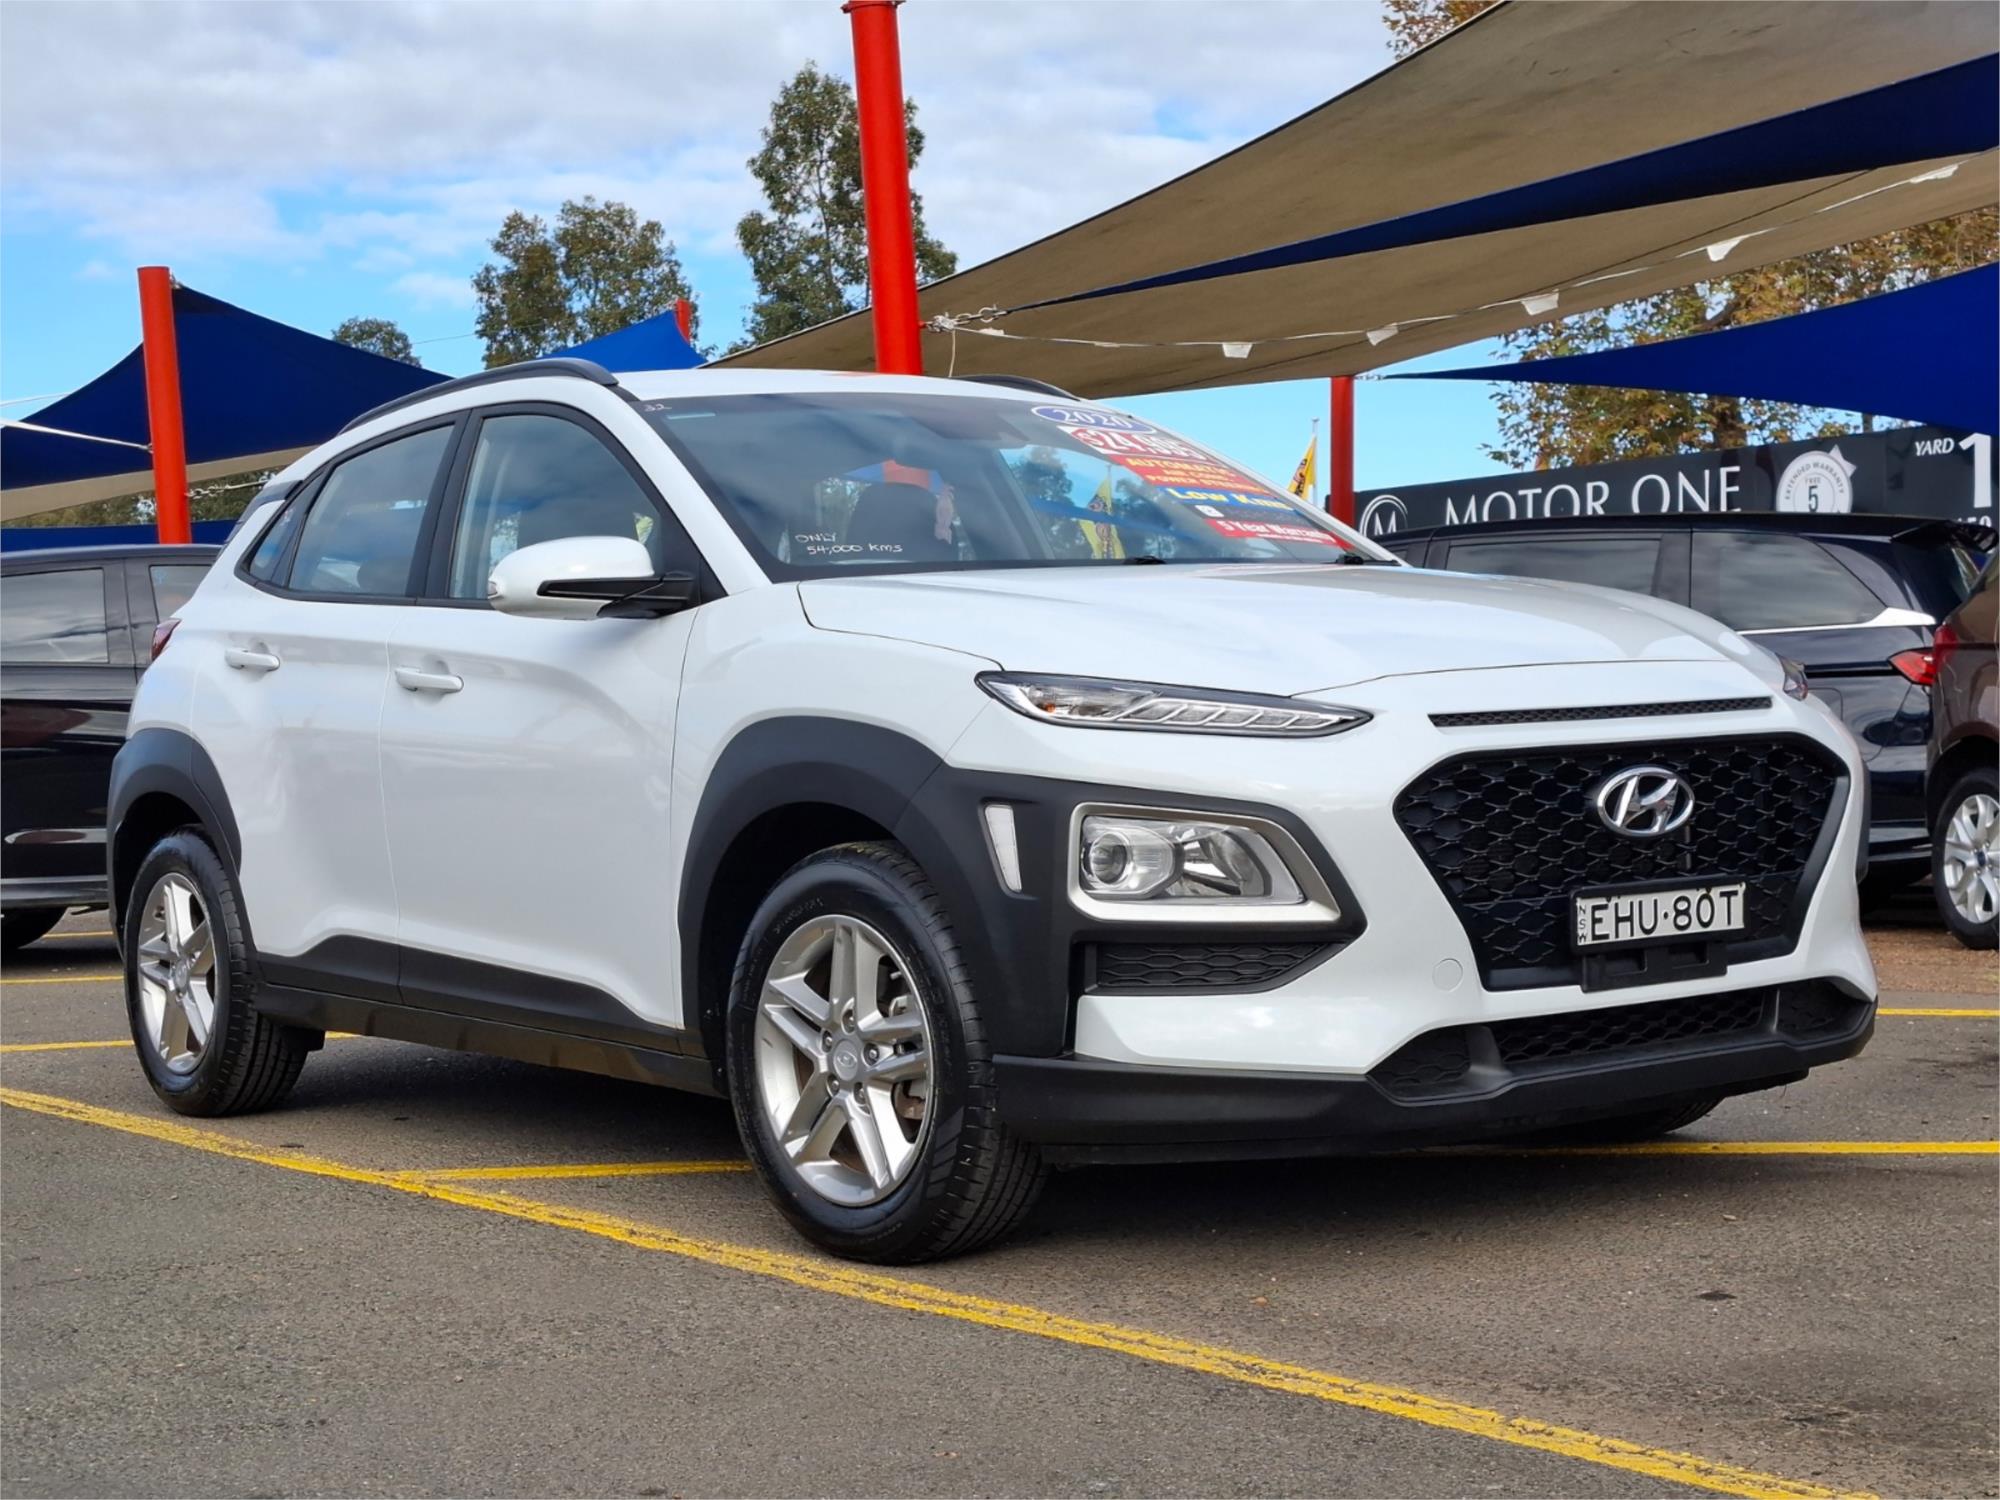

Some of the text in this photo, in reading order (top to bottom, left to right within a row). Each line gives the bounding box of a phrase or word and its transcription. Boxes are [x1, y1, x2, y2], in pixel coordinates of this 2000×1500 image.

[1053, 408, 1133, 429] 2020
[1785, 462, 1844, 500] EXTENDED WARRANTY
[1915, 432, 1992, 508] YARD 1
[1445, 465, 1742, 526] MOTOR ONE
[1808, 485, 1819, 513] 5
[795, 532, 837, 543] ONLY
[1216, 520, 1235, 531] 5
